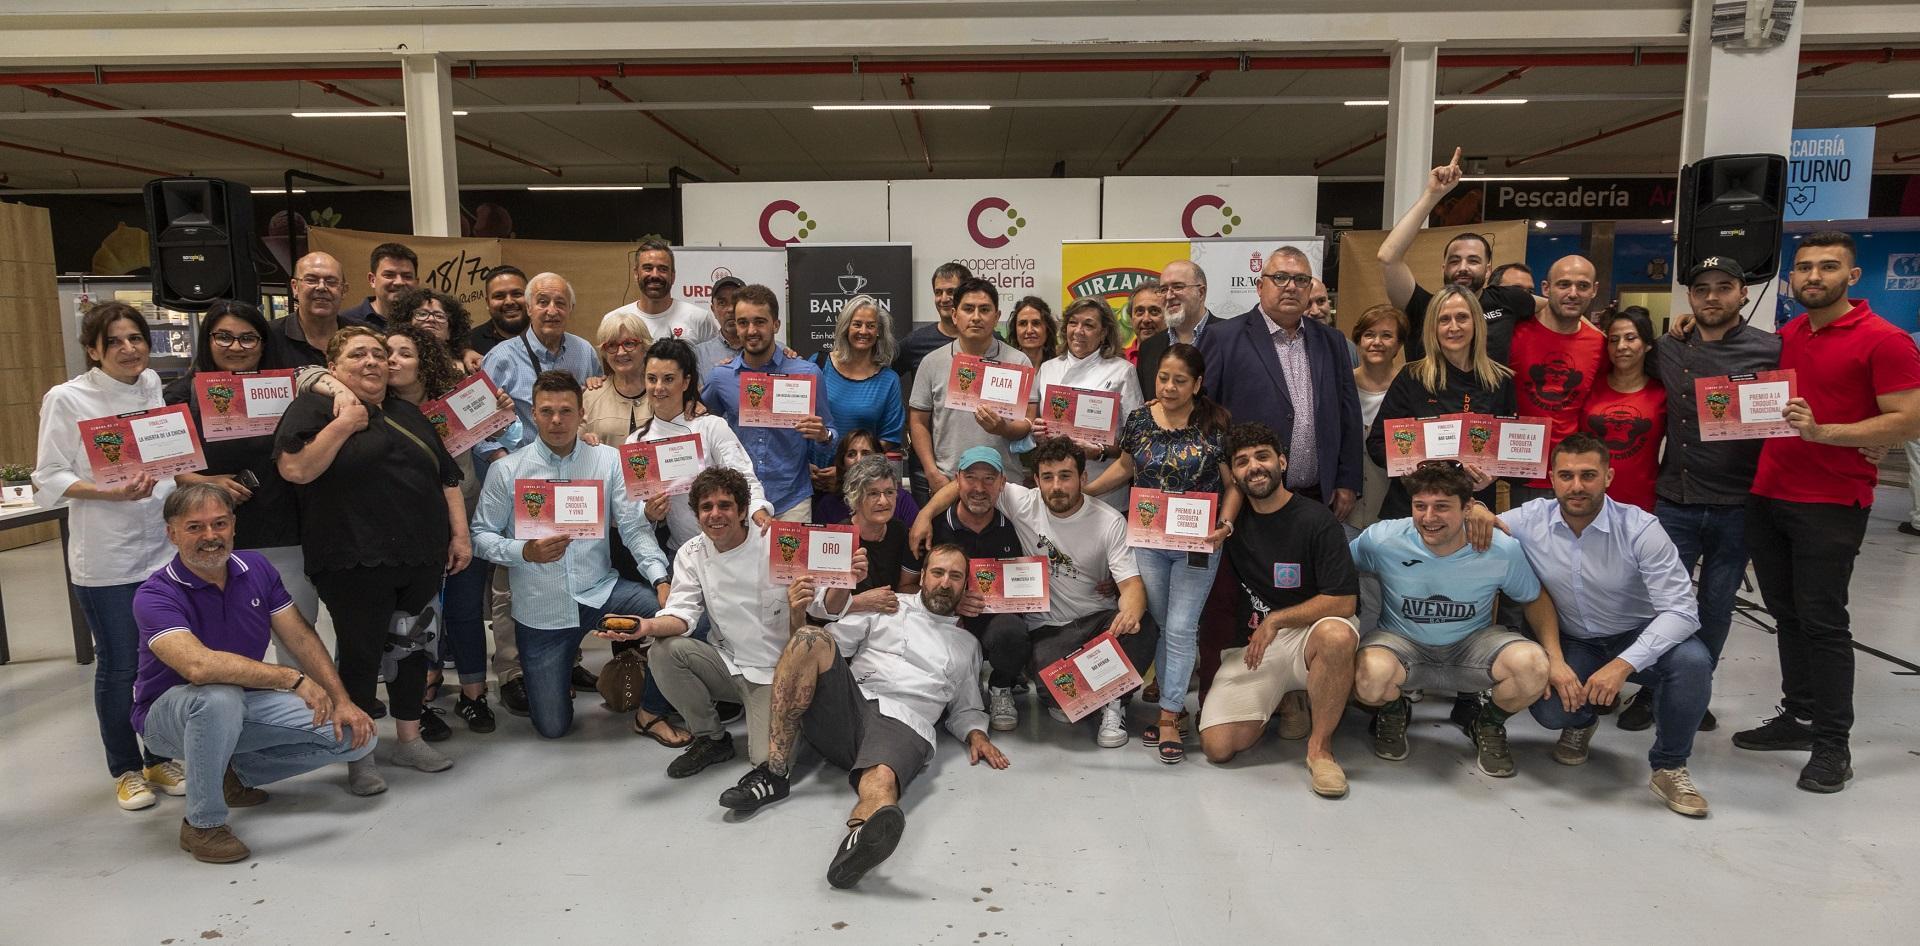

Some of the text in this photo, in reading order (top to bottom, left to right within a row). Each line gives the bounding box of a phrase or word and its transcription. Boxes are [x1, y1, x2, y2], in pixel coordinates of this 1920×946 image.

[1790, 158, 1850, 183] TURNO
[1499, 184, 1629, 208] Pescadería
[990, 376, 1012, 389] PLATA
[250, 387, 289, 400] BRONCE
[1749, 406, 1782, 414] TRADICIONAL
[145, 434, 160, 442] HUERTA
[1175, 507, 1193, 515] PREMIO
[1177, 514, 1199, 522] CROQUETA
[822, 542, 840, 555] ORO
[1401, 598, 1476, 618] AVENIDA
